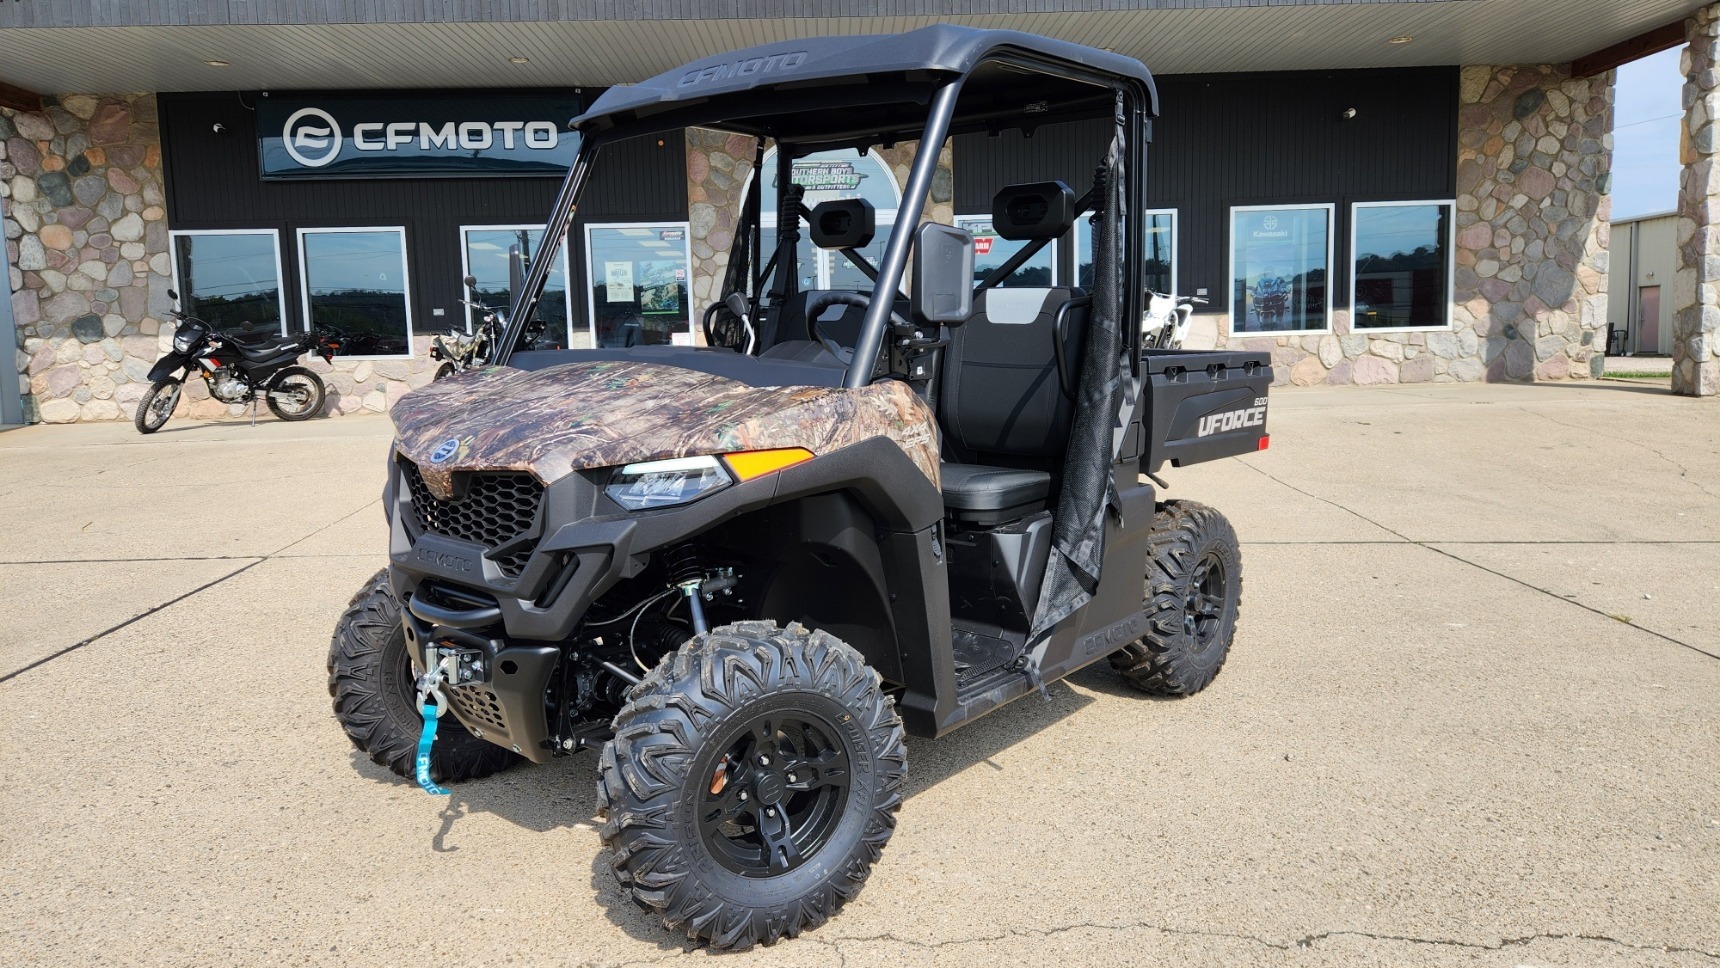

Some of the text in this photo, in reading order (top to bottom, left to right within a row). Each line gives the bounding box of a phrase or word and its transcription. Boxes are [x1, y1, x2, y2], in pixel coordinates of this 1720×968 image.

[677, 51, 809, 89] CFMOTO
[353, 121, 559, 151] CFMOTO
[792, 174, 860, 185] TORSPORTS
[1253, 230, 1288, 238] Kawasaki
[974, 242, 989, 250] ARN
[1254, 396, 1268, 407] 600
[1198, 406, 1267, 438] UFORCE
[417, 548, 473, 572] CFMOTO
